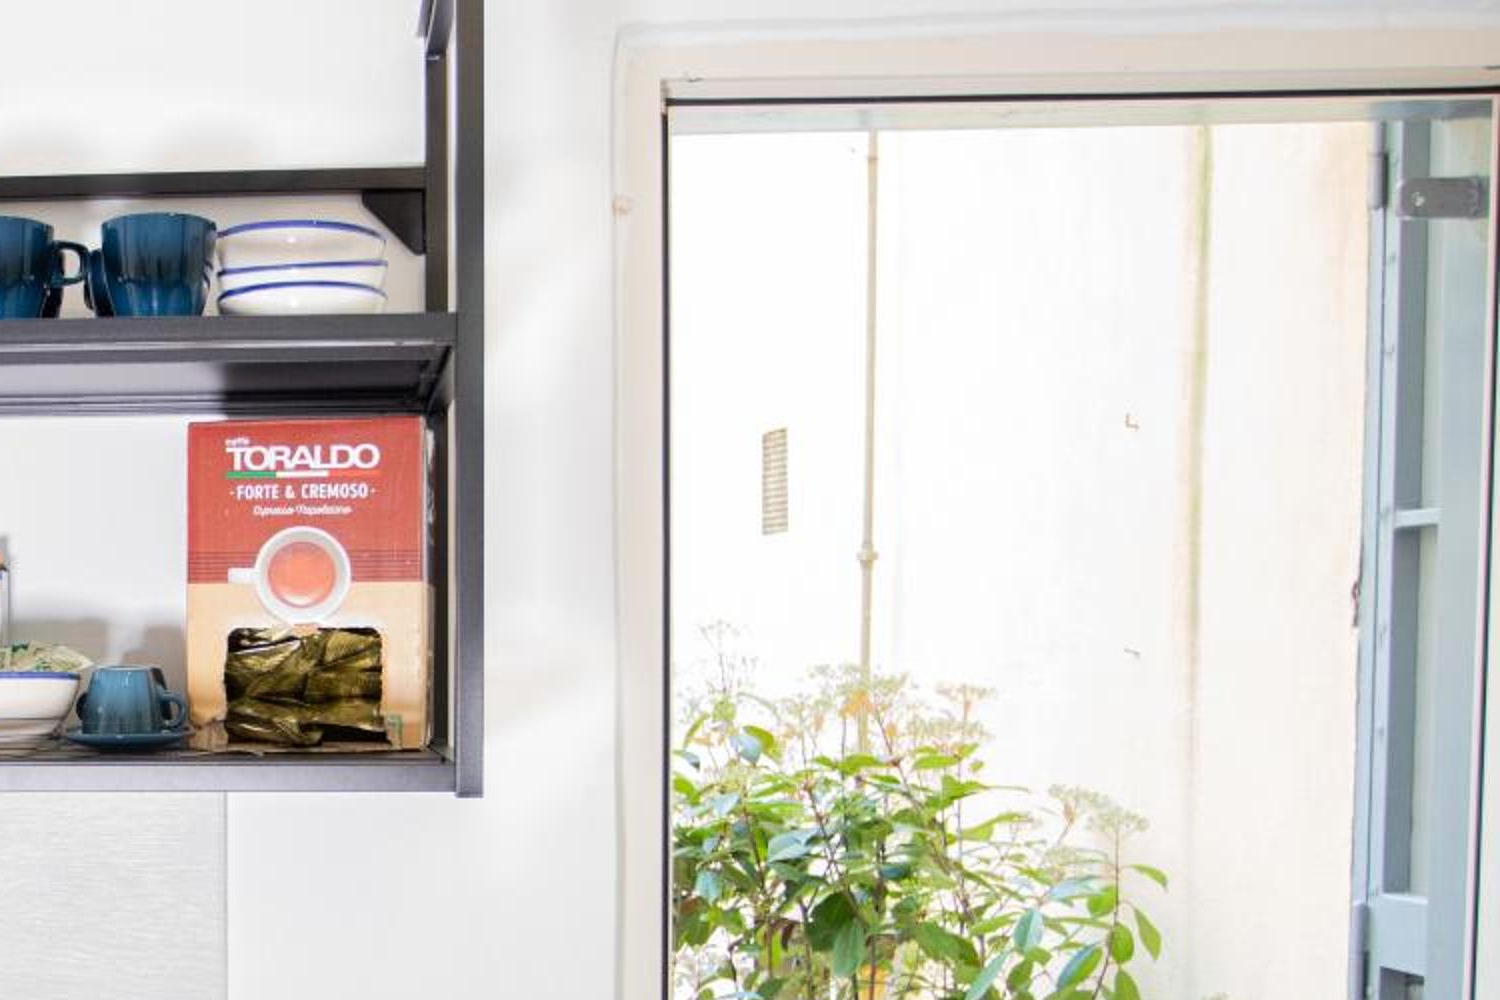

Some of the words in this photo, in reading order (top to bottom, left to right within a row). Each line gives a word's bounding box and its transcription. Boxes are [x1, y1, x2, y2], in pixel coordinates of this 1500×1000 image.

[225, 443, 381, 471] TORALDO
[236, 484, 280, 500] FORTE
[285, 485, 296, 499] &
[301, 482, 369, 499] CREMOSO
